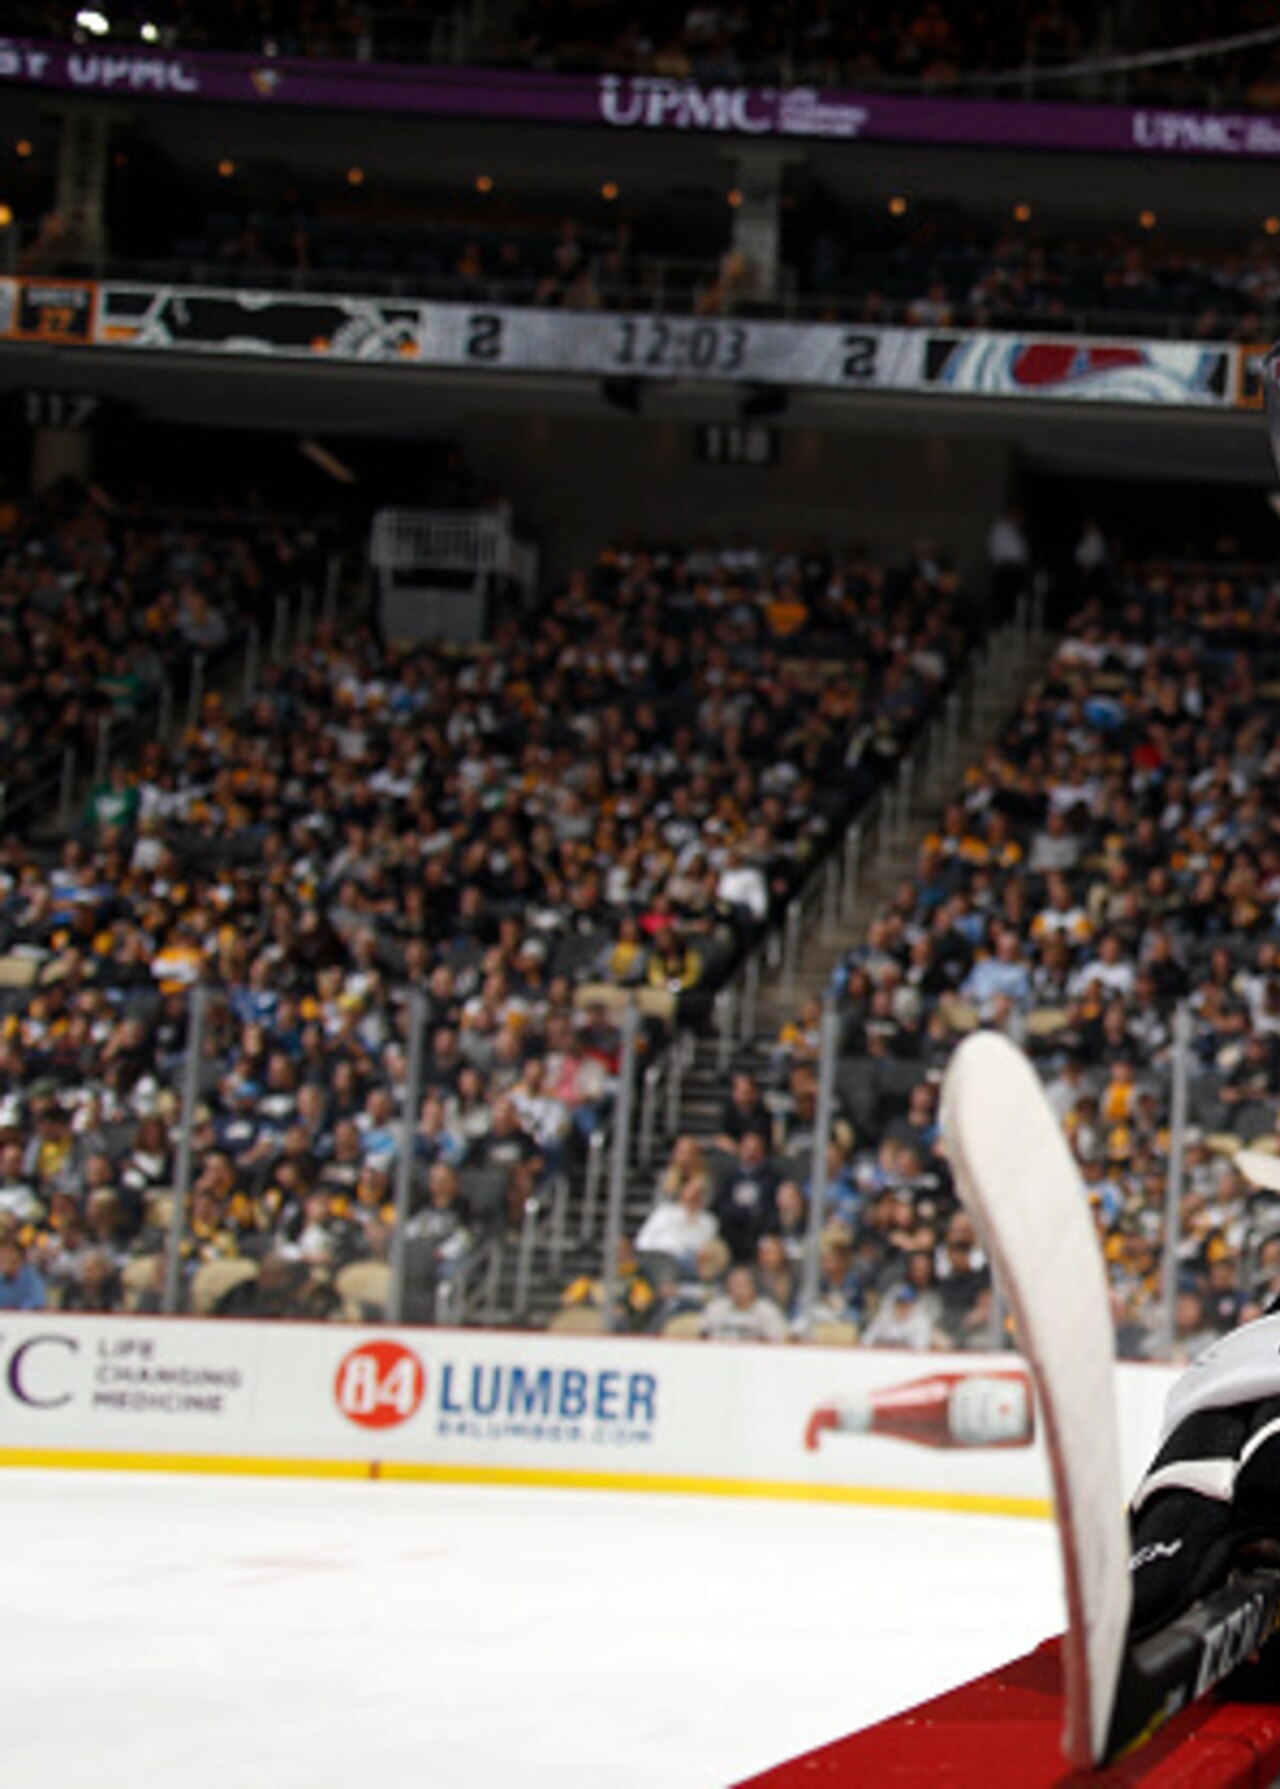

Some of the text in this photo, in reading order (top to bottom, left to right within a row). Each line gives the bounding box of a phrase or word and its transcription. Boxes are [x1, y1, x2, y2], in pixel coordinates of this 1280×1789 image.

[598, 74, 774, 135] UPMC
[1131, 111, 1247, 154] UPMC
[466, 315, 503, 359] 2
[613, 319, 749, 372] 12:03
[841, 335, 880, 379] 2
[97, 1338, 156, 1360] LIFE
[95, 1362, 243, 1390] CHANGING
[339, 1353, 418, 1416] 84
[441, 1365, 658, 1422] LUMBER
[92, 1391, 224, 1416] MEDICINE
